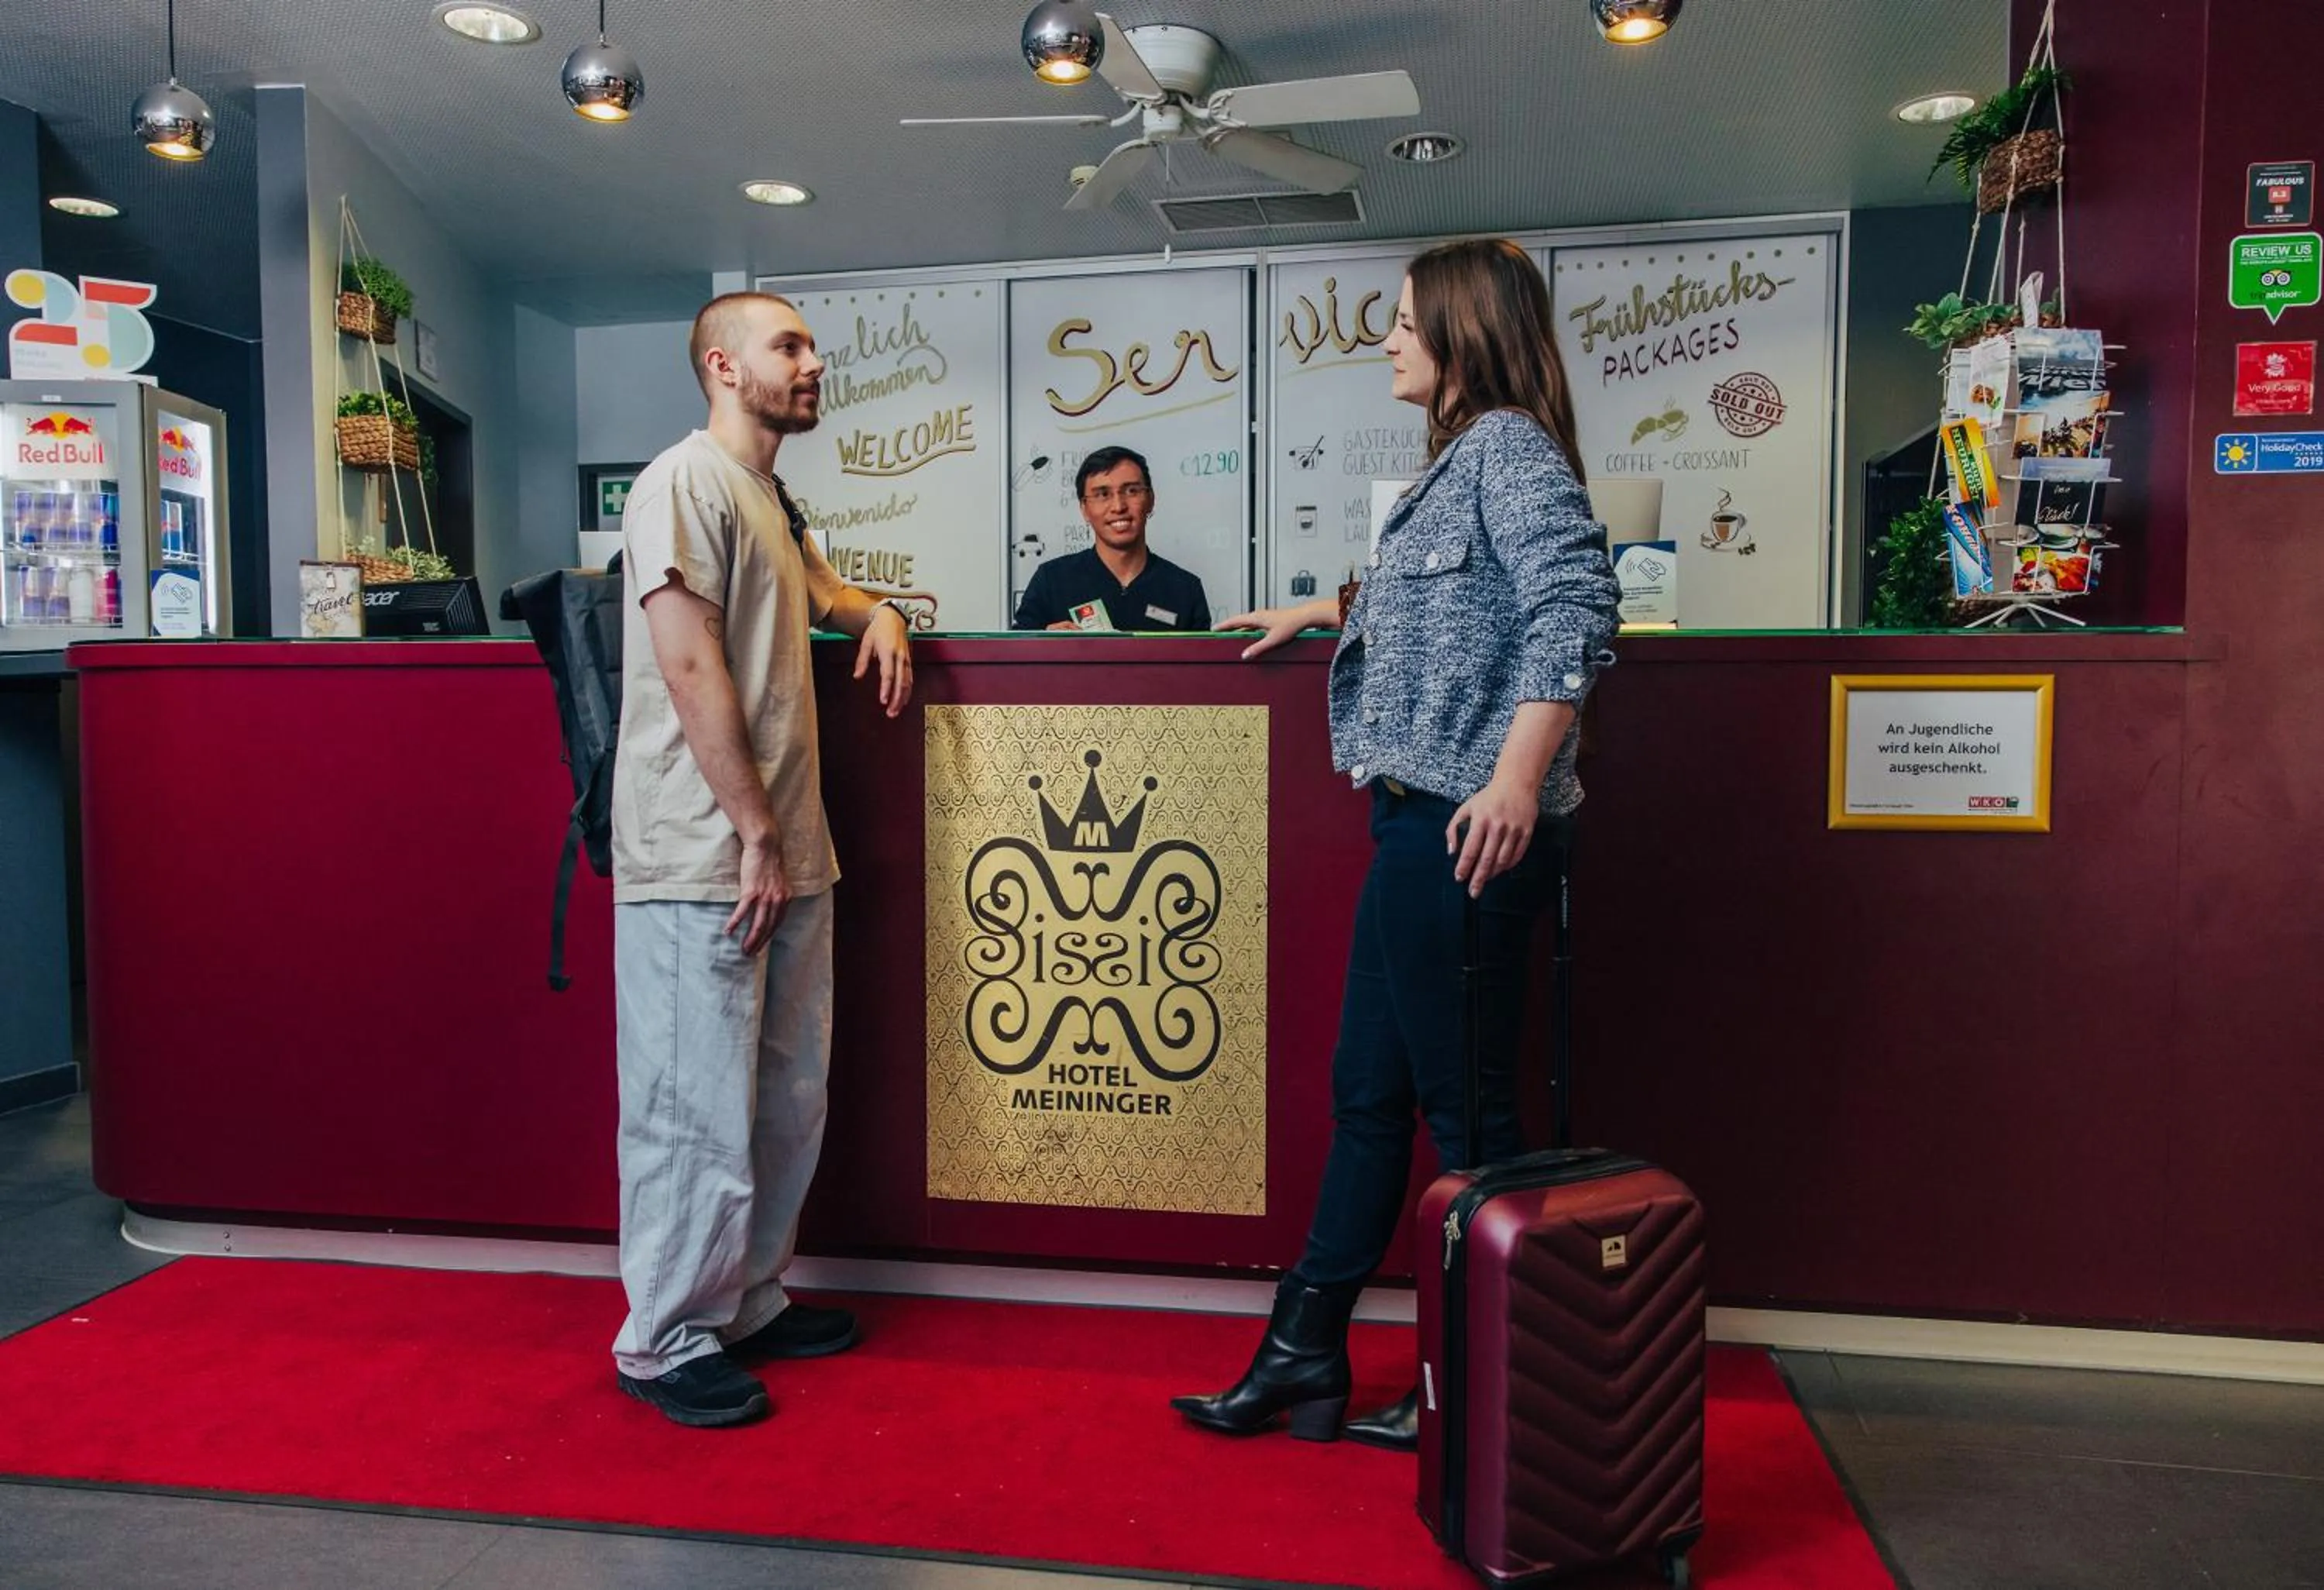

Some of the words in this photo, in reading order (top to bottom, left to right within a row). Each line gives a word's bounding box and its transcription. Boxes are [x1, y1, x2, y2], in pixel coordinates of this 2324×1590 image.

[2241, 246, 2291, 257] REVIEW
[2295, 244, 2312, 255] US
[1280, 277, 1399, 363] vic
[1603, 318, 1740, 387] PACKAGES
[2248, 384, 2269, 394] Very
[1710, 388, 1748, 409] SOLD
[1755, 402, 1786, 419] OUT
[837, 404, 974, 470] WELCOME
[19, 444, 58, 463] Red
[64, 444, 104, 464] Bull
[2261, 442, 2322, 454] HolidayCheck
[1342, 453, 1385, 475] GUEST
[1606, 453, 1655, 472] COFFEE
[1673, 449, 1752, 470] CROISSANT
[2295, 456, 2323, 467] 2019
[365, 591, 400, 606] acer
[1886, 724, 1904, 735] An
[1909, 723, 1993, 738] Jugendliche
[1879, 742, 1909, 754] wird
[1914, 742, 1944, 755] kein
[1948, 742, 2000, 755] Alkohol
[1889, 761, 1988, 776] ausgeschenkt.
[1970, 797, 2004, 807] WKO
[1074, 821, 1110, 847] M
[1048, 1064, 1138, 1087] HOTEL
[1012, 1089, 1172, 1116] MEININGER
